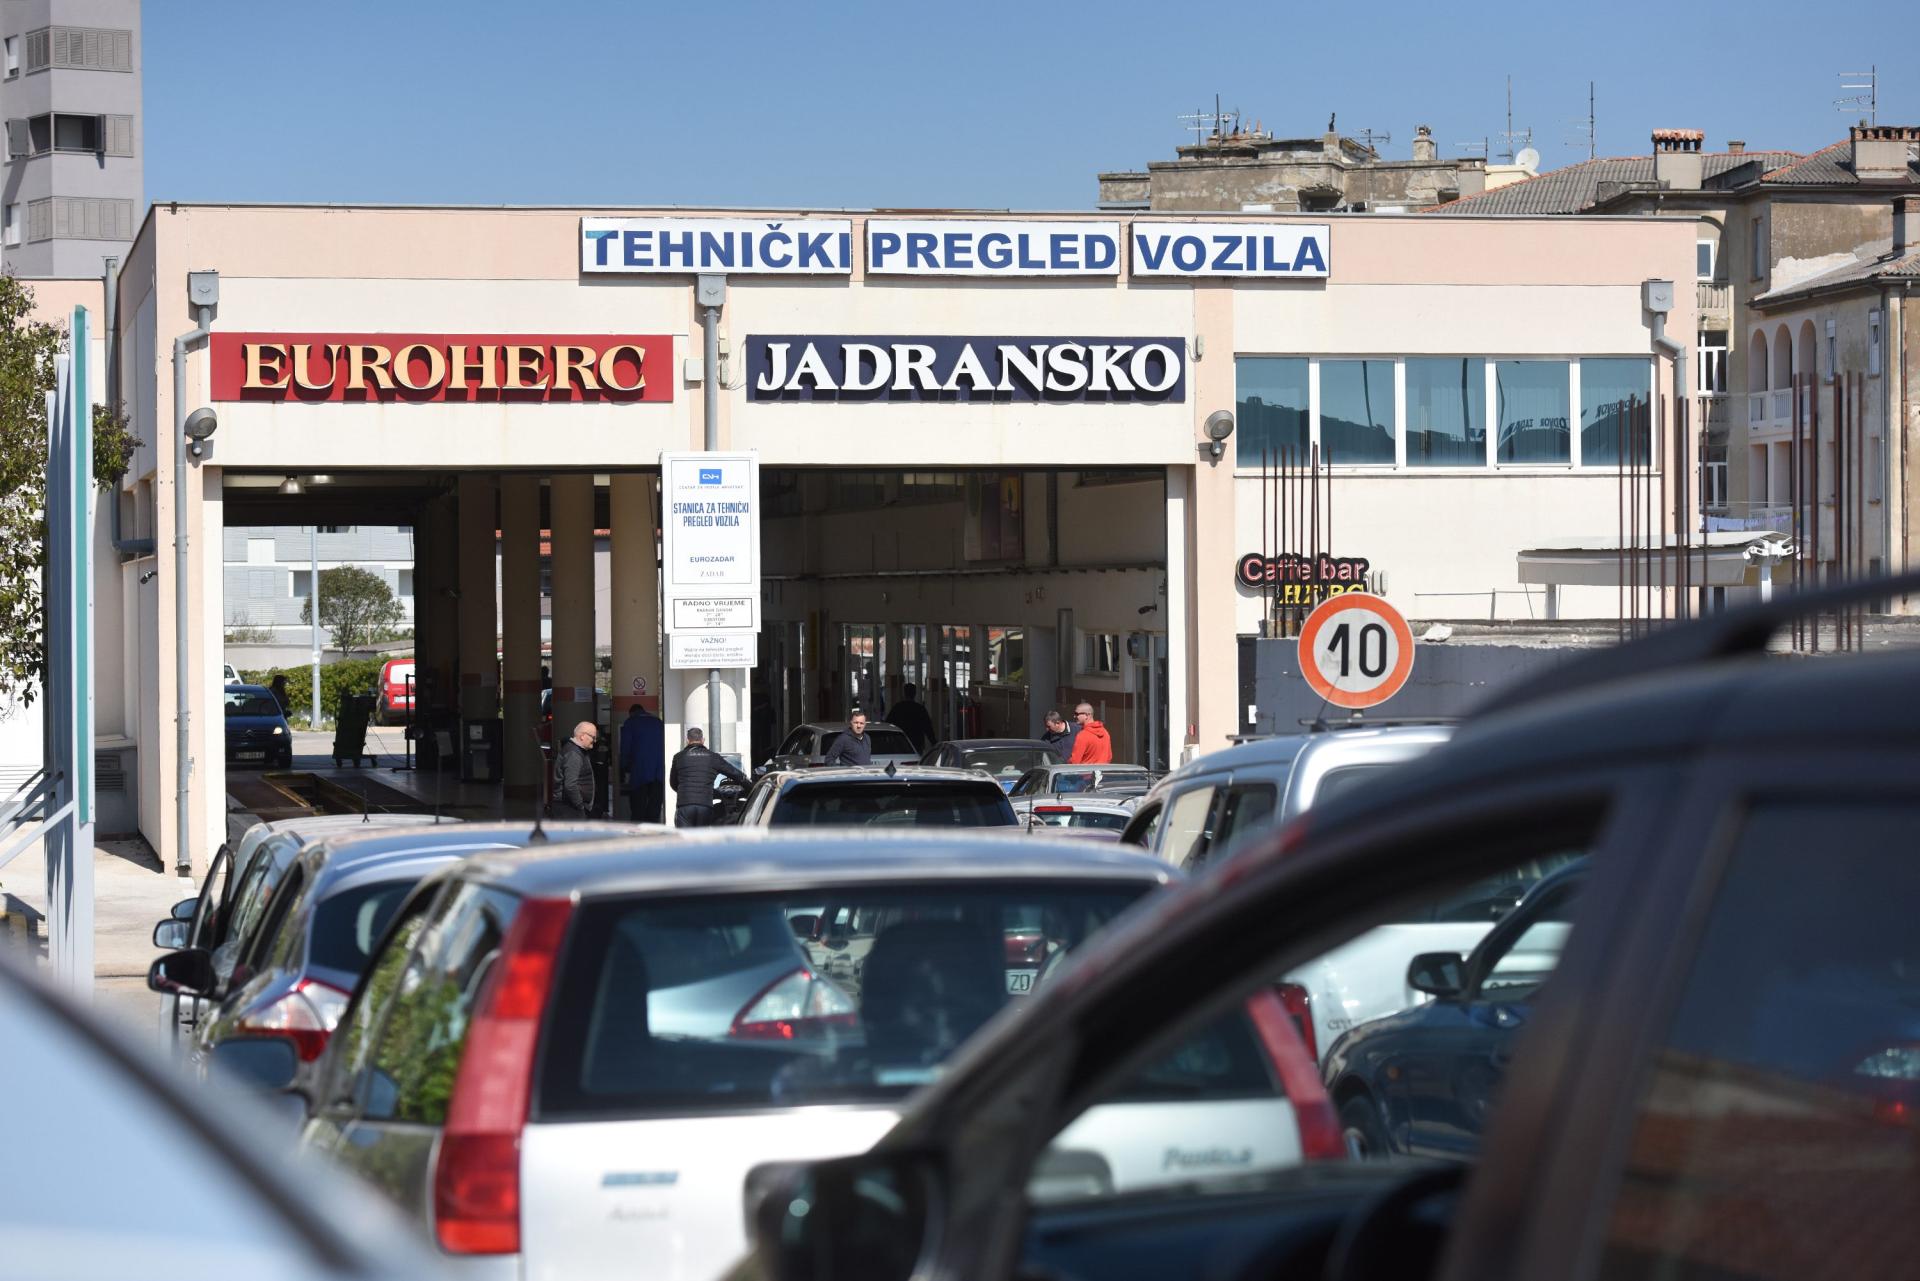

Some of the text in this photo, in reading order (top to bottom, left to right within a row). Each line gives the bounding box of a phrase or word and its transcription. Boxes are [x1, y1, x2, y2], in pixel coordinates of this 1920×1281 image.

[585, 223, 1327, 272] TEHNIČKI PREGLED VOZILA
[242, 343, 647, 391] EUROHERC
[756, 342, 1181, 392] JADRANSKO
[673, 501, 749, 514] STANICA ZA TEHNIČKI
[683, 516, 740, 527] PREGLED VOZILA
[1243, 557, 1365, 581] Caffe bar
[1327, 623, 1388, 678] 10
